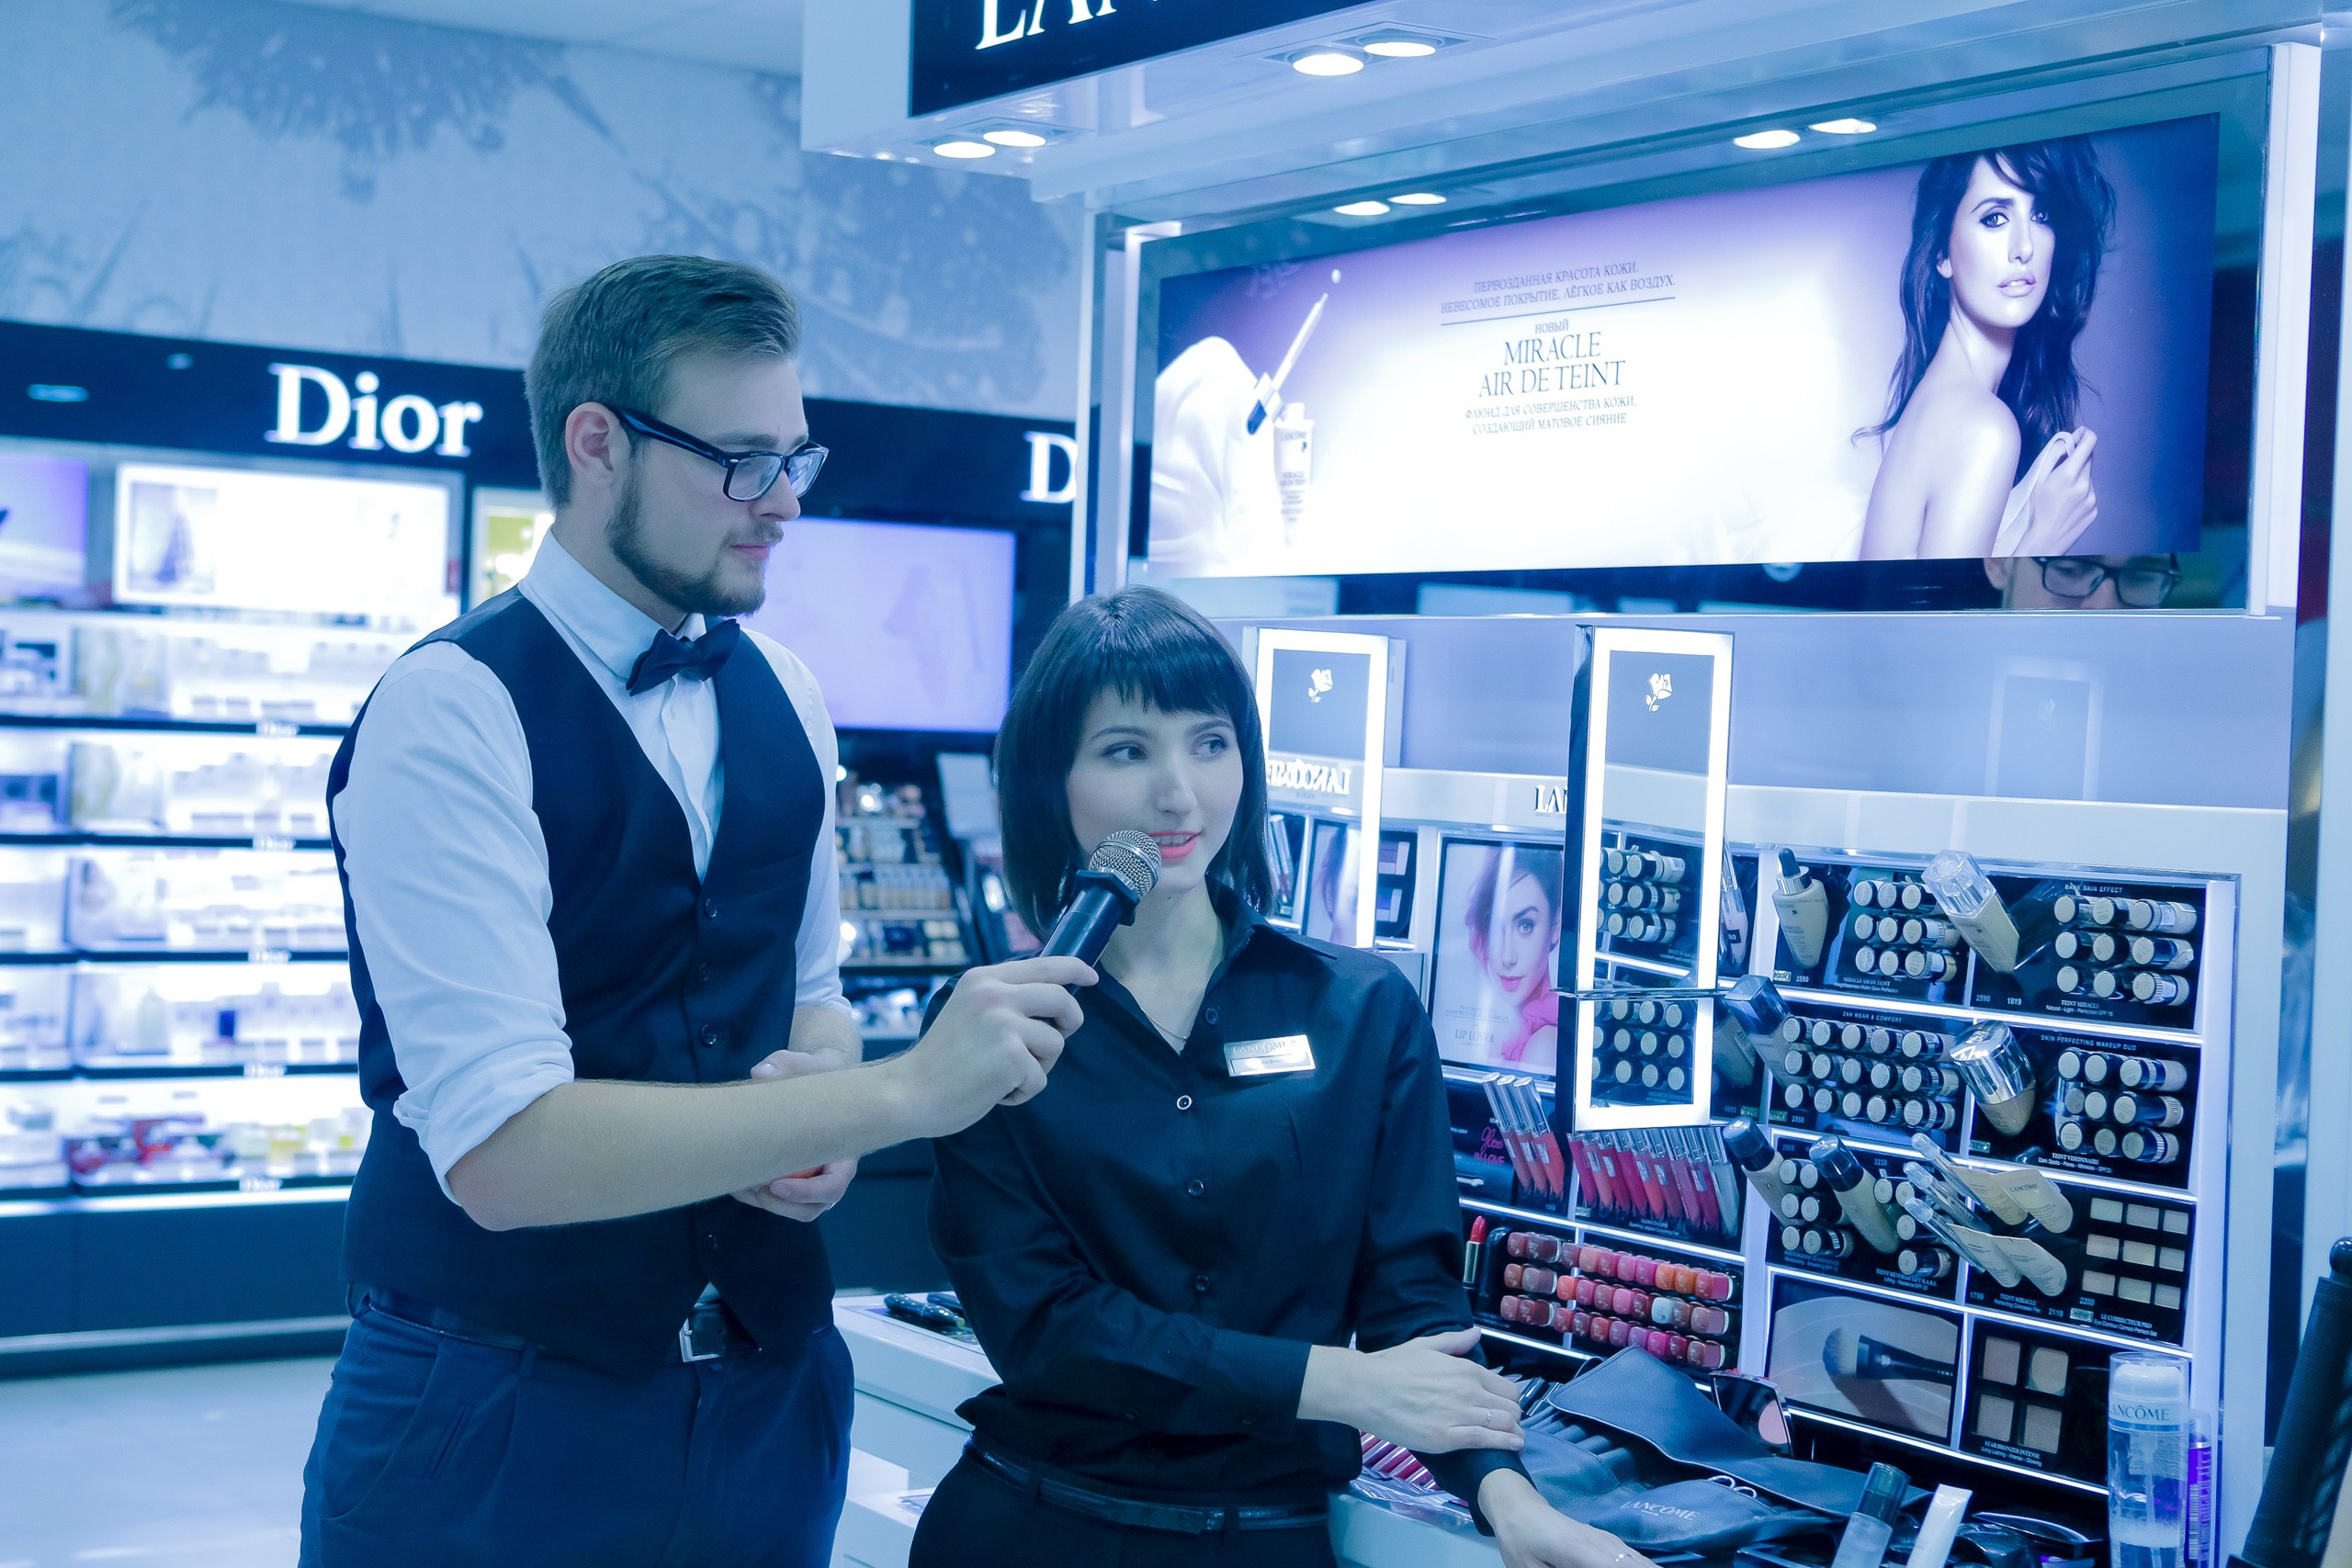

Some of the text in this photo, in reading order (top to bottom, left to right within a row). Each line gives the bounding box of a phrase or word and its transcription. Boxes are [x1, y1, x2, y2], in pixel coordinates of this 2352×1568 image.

[1474, 262, 1639, 293] ПЕРВОЗДАННАЯ КРАСОТА КОЖИ.
[1441, 296, 1501, 313] НЕВЕСОМОЕ
[1503, 289, 1561, 306] ПОКРЫТИЕ,
[1607, 279, 1628, 294] КАК
[1630, 275, 1676, 291] ВОЗДУХ.
[1534, 319, 1569, 333] НОВЫЙ
[1504, 332, 1601, 366] MIRACLE
[1478, 360, 1626, 397] AIR DE TEINT
[264, 362, 483, 457] Dior
[1502, 405, 1521, 417] ДЛЯ
[1522, 399, 1600, 415] СОВЕРШЕНСТВА
[1472, 412, 1627, 434] СОЗДАЮЩИЙ МАТОВОЕ СИЯНИЕ
[1455, 1029, 1495, 1043] LIP LOVER
[2057, 1036, 2094, 1046] PERFECTING
[2096, 1040, 2121, 1049] MAKEUP
[2123, 1043, 2137, 1051] DUO
[2109, 1404, 2169, 1420] ANCÔME
